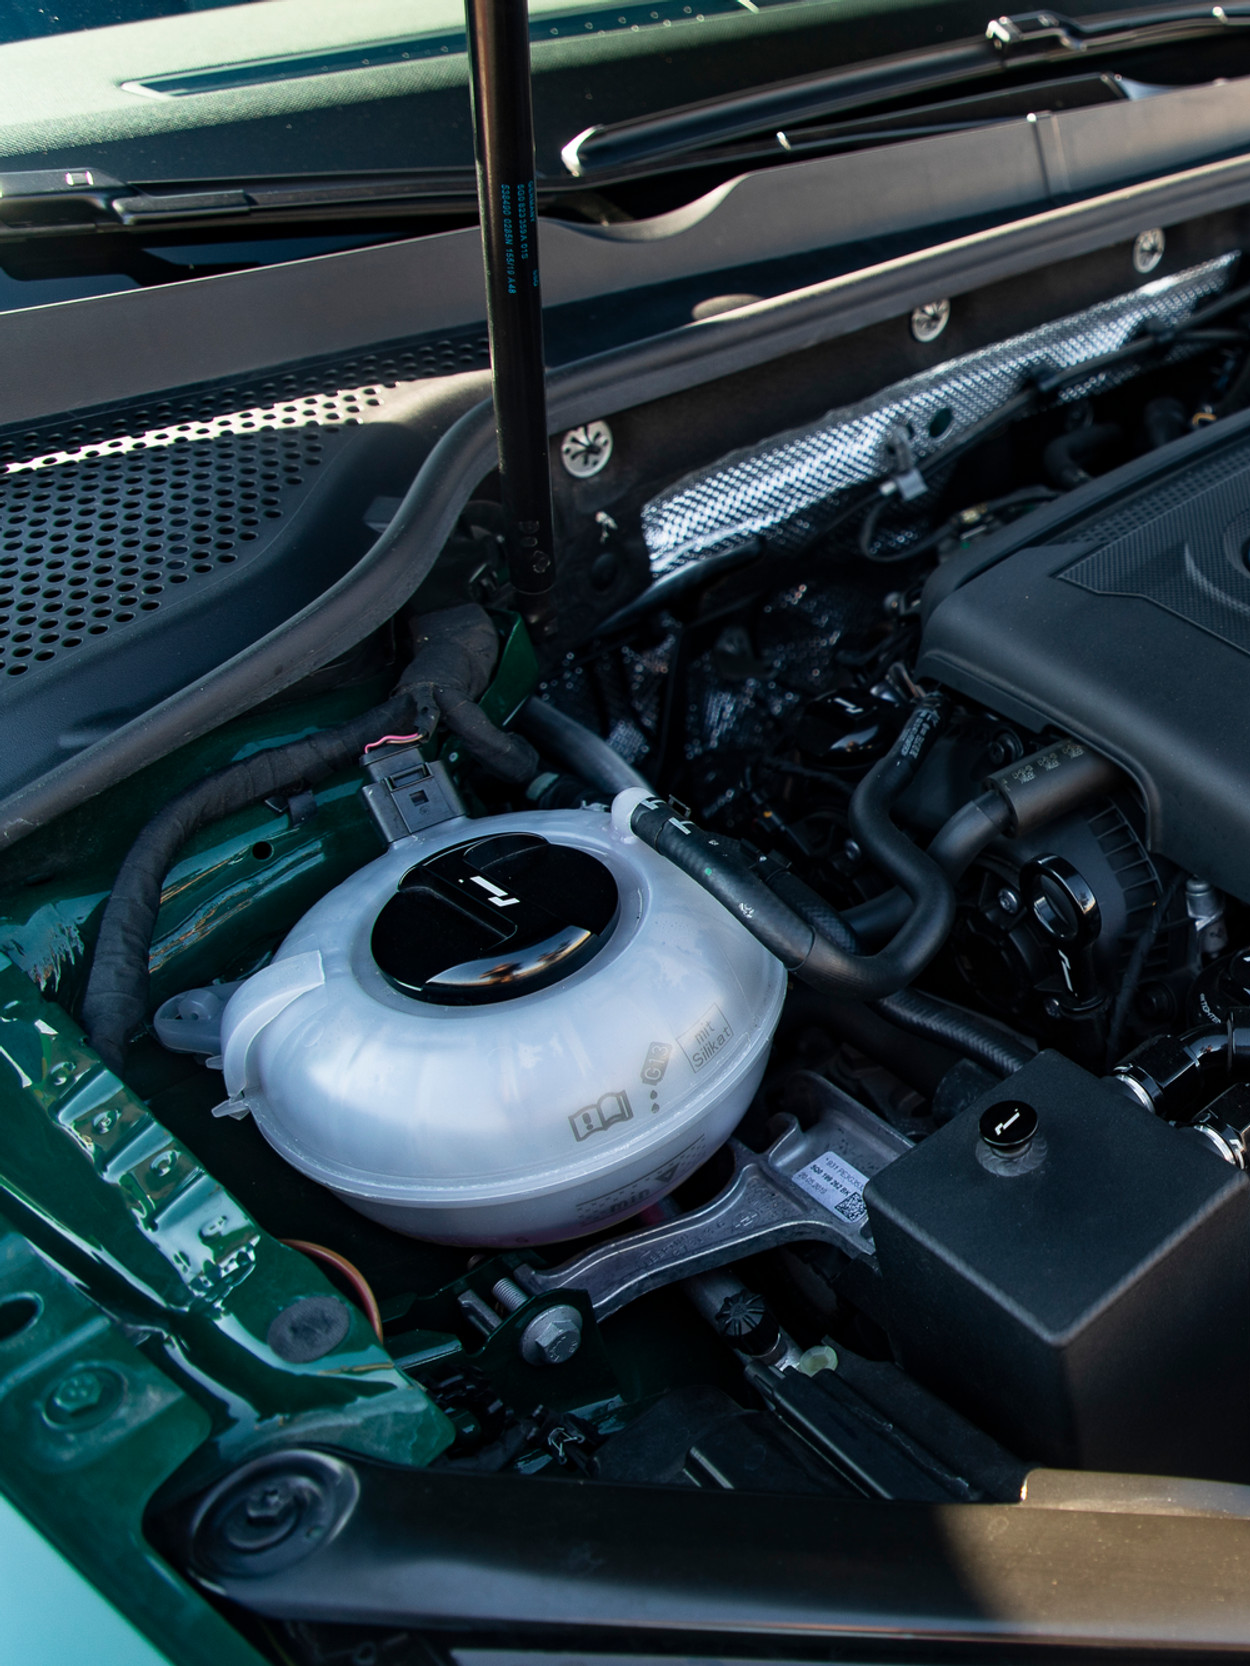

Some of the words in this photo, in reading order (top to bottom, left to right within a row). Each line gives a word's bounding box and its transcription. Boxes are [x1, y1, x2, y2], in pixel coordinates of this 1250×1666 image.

[692, 1026, 732, 1069] Silikat
[694, 1020, 716, 1046] mit
[644, 1045, 668, 1081] G13
[608, 1188, 651, 1213] min
